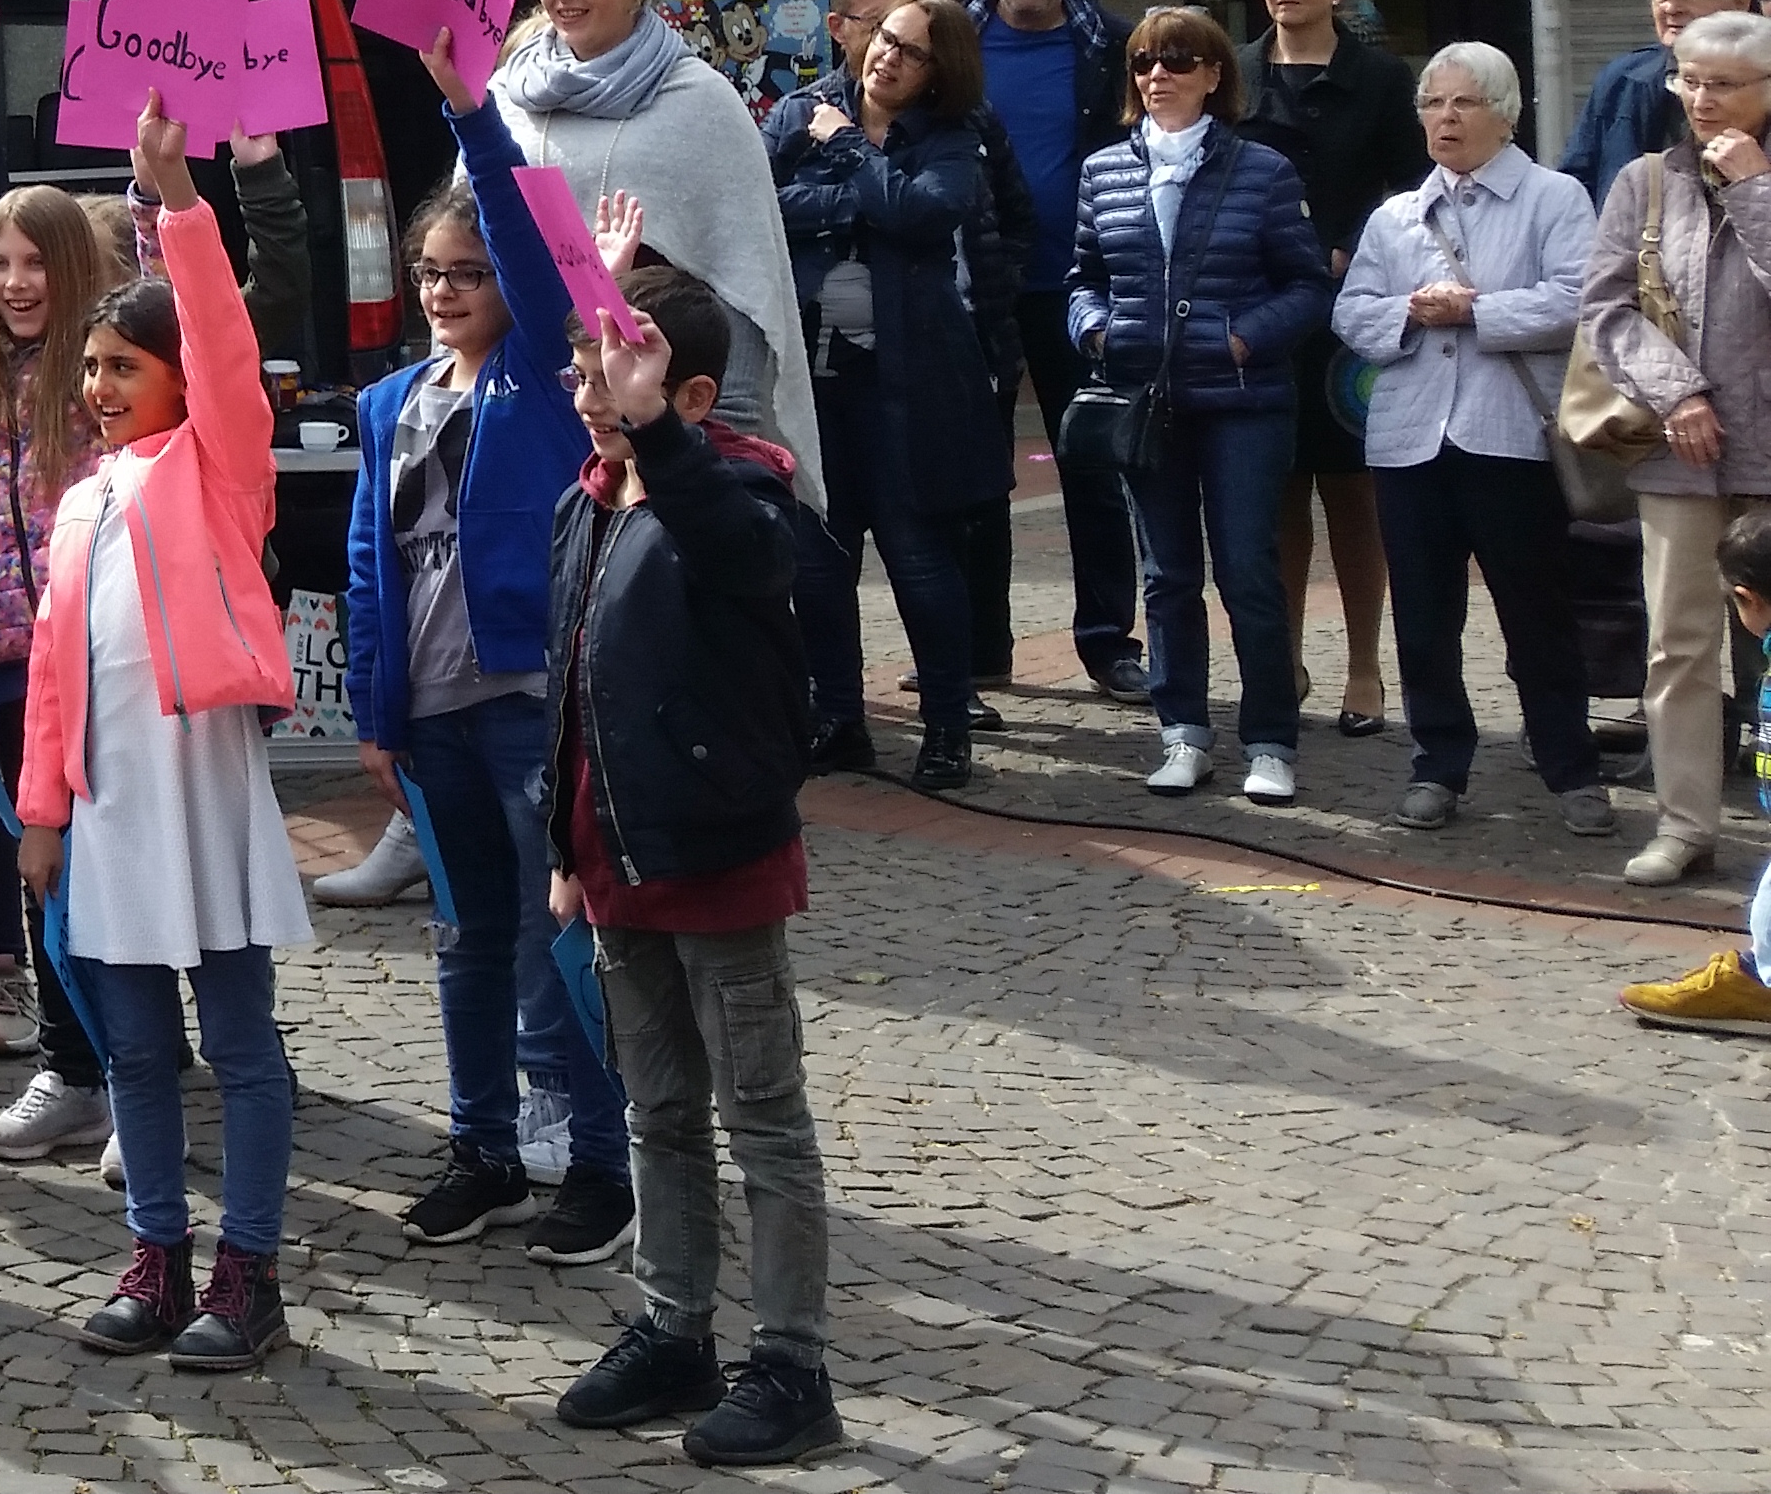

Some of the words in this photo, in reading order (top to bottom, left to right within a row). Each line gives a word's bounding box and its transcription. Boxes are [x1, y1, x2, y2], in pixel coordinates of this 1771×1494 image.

[294, 632, 305, 664] VERY
[305, 633, 350, 670] LO
[293, 666, 343, 704] TH
